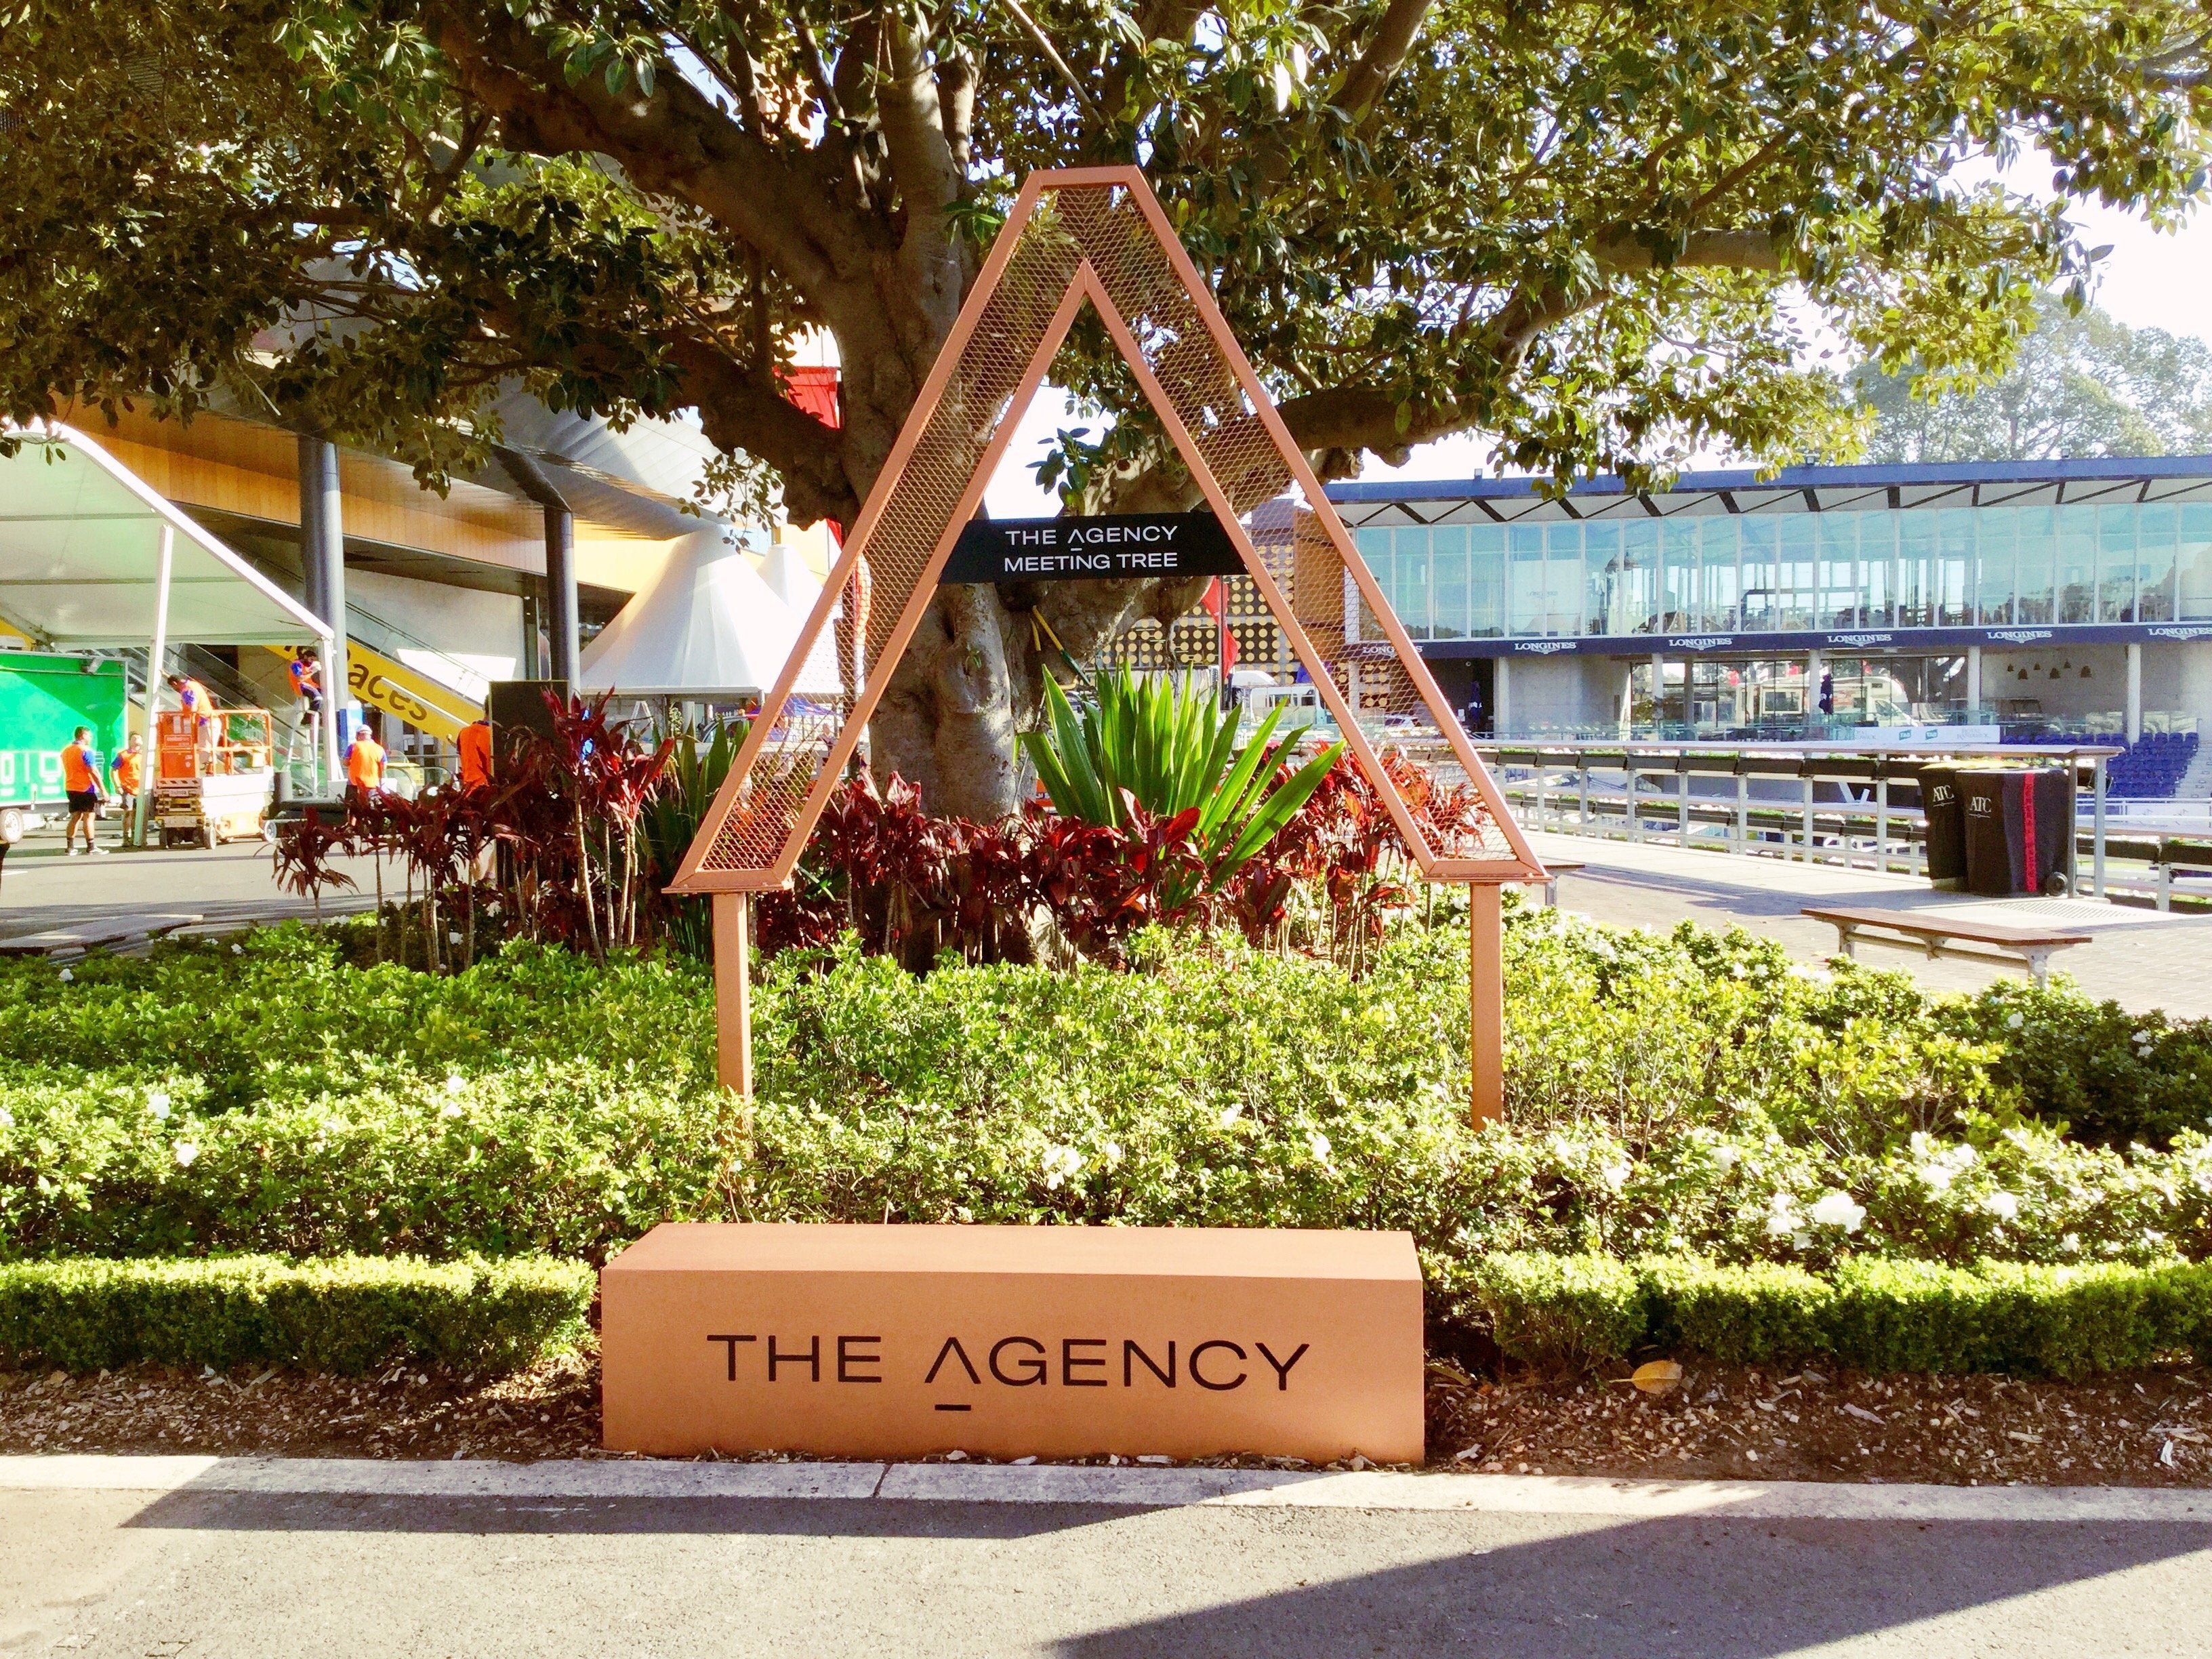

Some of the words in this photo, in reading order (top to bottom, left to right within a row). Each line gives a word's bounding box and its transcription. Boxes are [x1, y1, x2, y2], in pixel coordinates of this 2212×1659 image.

[1005, 529, 1057, 546] THE
[1067, 525, 1179, 551] AGENCY
[1004, 554, 1111, 572] MEETING
[1115, 552, 1179, 569] TREE
[1827, 634, 1893, 643] LONGINES
[1986, 630, 2053, 639] LONGINES
[2148, 628, 2212, 636] LONGINES
[1514, 642, 1578, 651] LONGINES
[1668, 637, 1733, 647] LONGINES
[346, 647, 428, 720] aces
[1932, 785, 1954, 802] ATC
[1969, 796, 1992, 813] ATC
[706, 1334, 882, 1383] THE
[924, 1336, 1310, 1412] AGENCY
